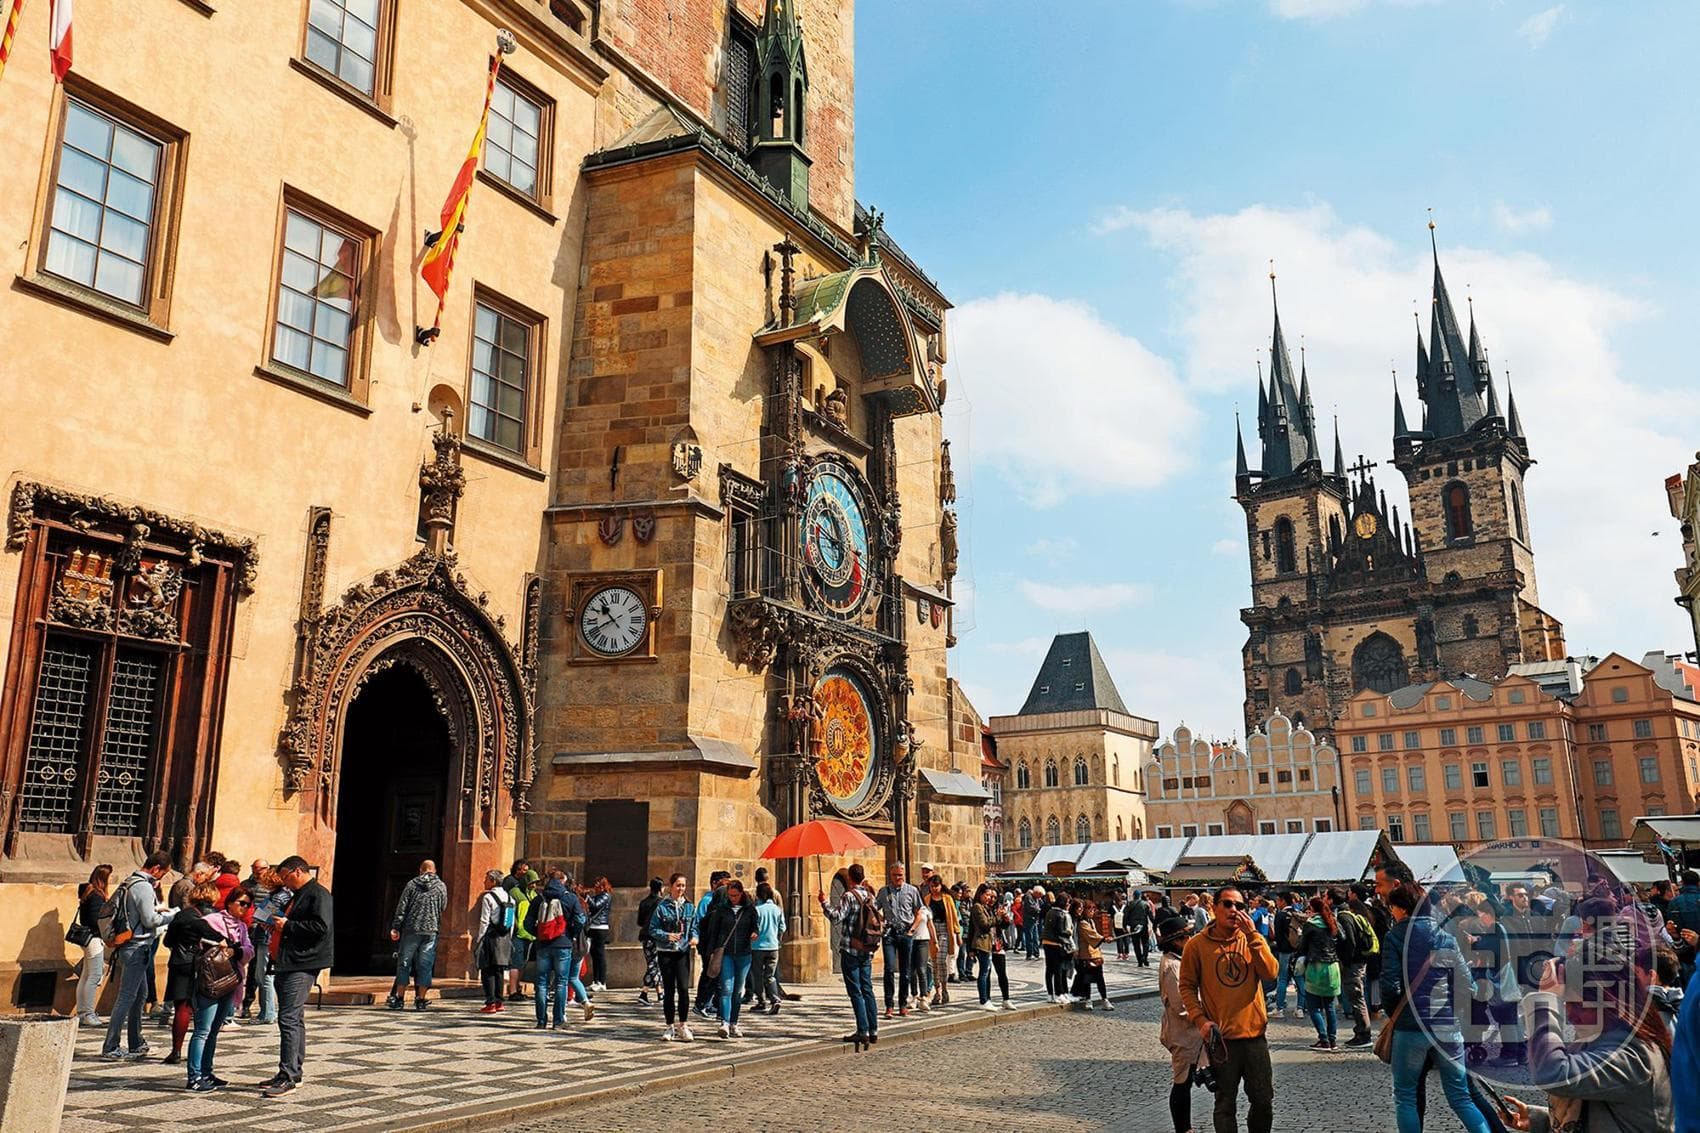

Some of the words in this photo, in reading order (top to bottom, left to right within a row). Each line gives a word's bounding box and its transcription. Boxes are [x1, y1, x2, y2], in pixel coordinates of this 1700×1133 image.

[610, 593, 620, 604] XII
[623, 596, 629, 606] I
[628, 604, 639, 613] II
[631, 616, 641, 624] III
